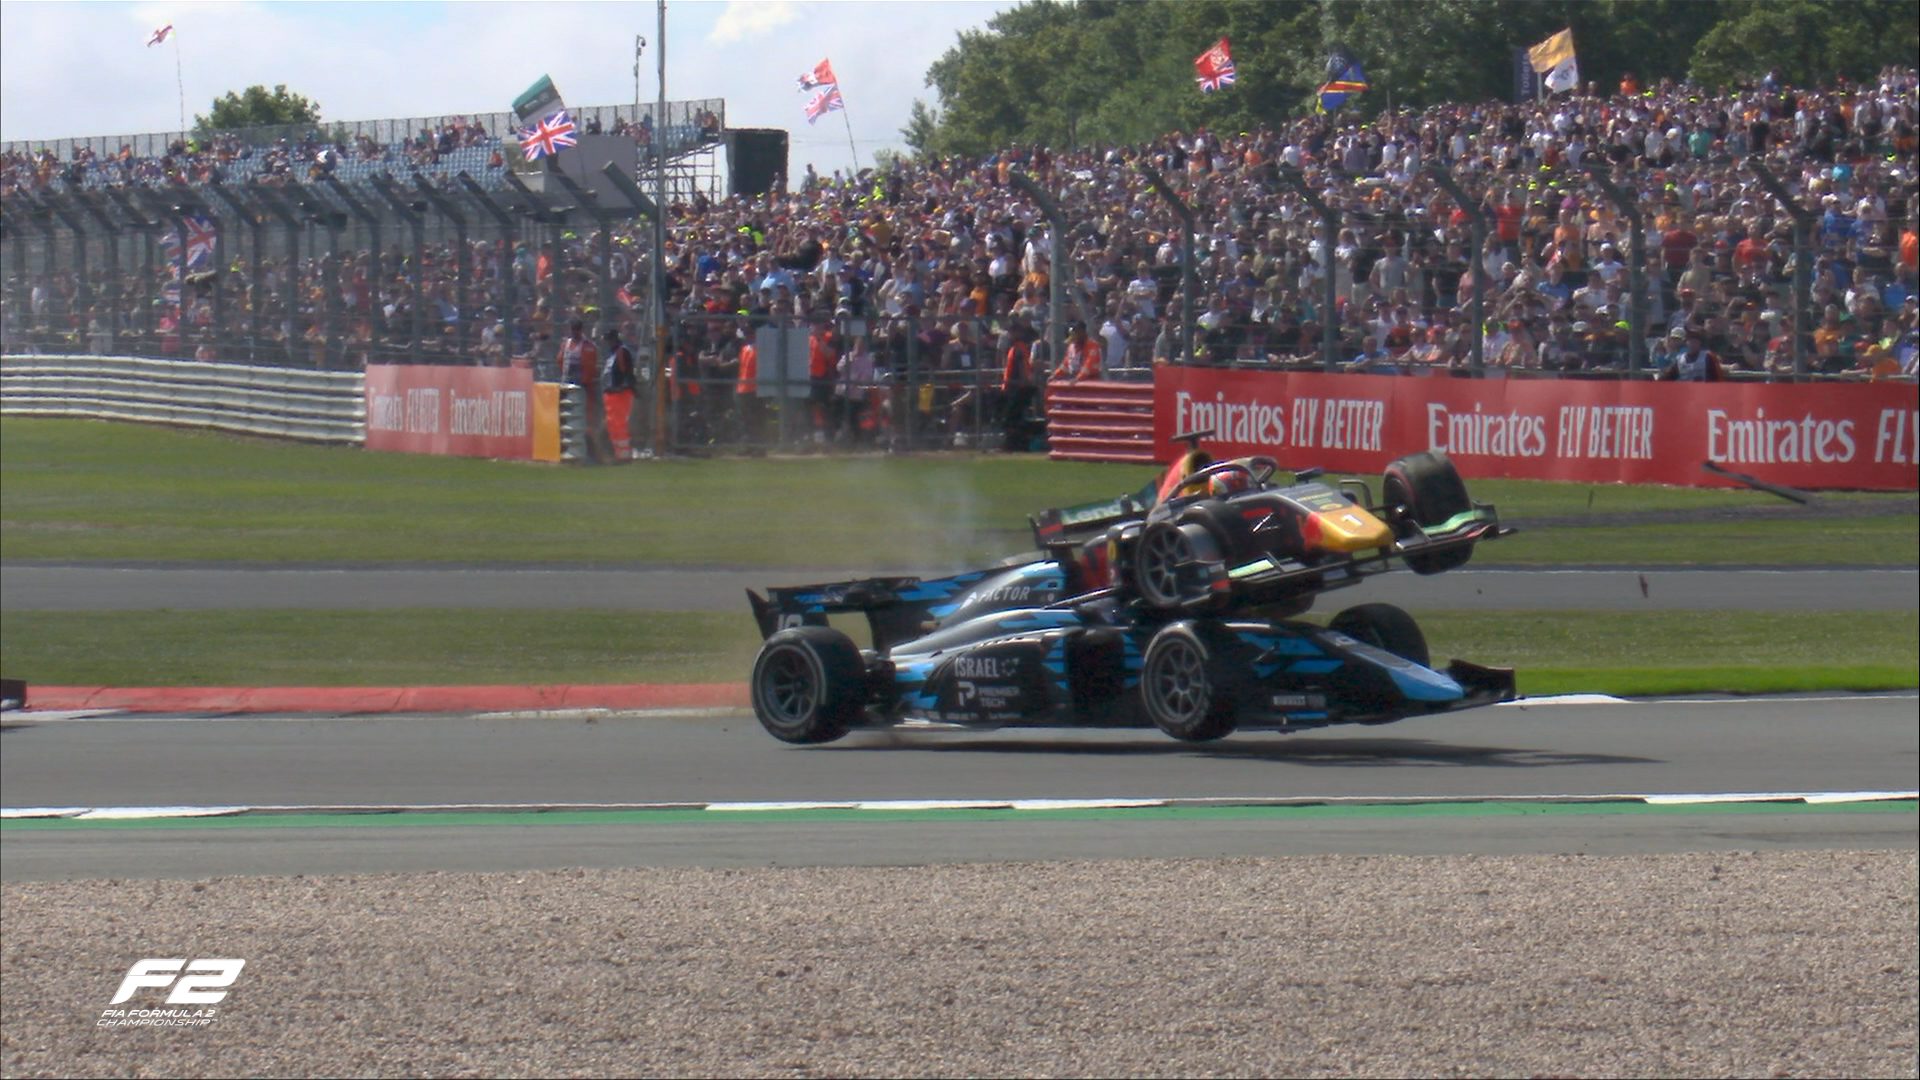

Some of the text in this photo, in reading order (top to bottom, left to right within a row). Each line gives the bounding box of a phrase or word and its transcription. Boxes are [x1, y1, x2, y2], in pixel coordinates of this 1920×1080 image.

[1176, 392, 1384, 451] Emirates FLY BETTER
[1427, 402, 1654, 460] Emirates FLY BETTER
[1707, 407, 1856, 464] Emirates
[955, 657, 1000, 678] ISRAEL
